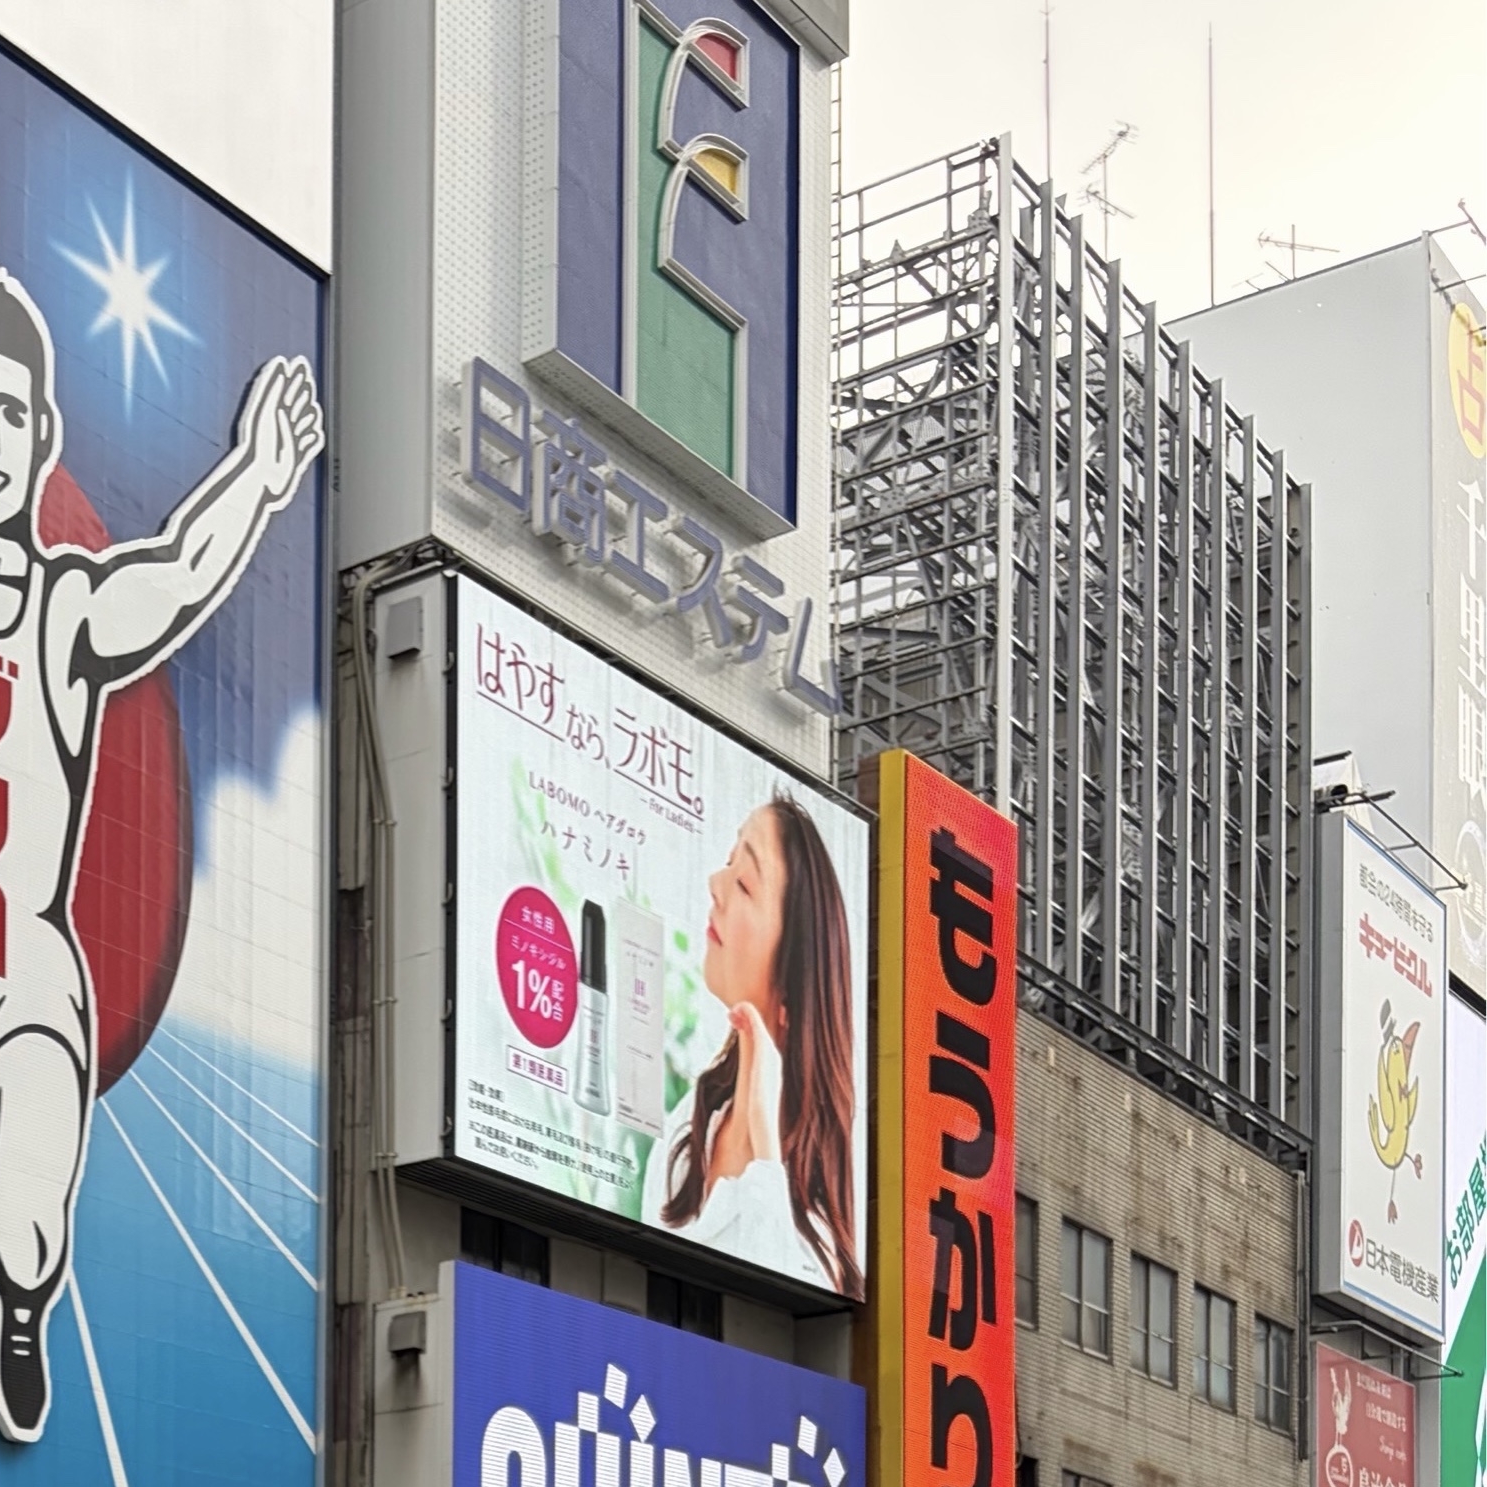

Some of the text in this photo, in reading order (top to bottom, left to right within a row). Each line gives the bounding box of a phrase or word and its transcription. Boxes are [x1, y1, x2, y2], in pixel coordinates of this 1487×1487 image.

[529, 771, 591, 817] LABOMO
[541, 821, 630, 881] ハナミノキ
[1359, 913, 1432, 997] キュービクル
[1445, 1130, 1487, 1289] お部屋
